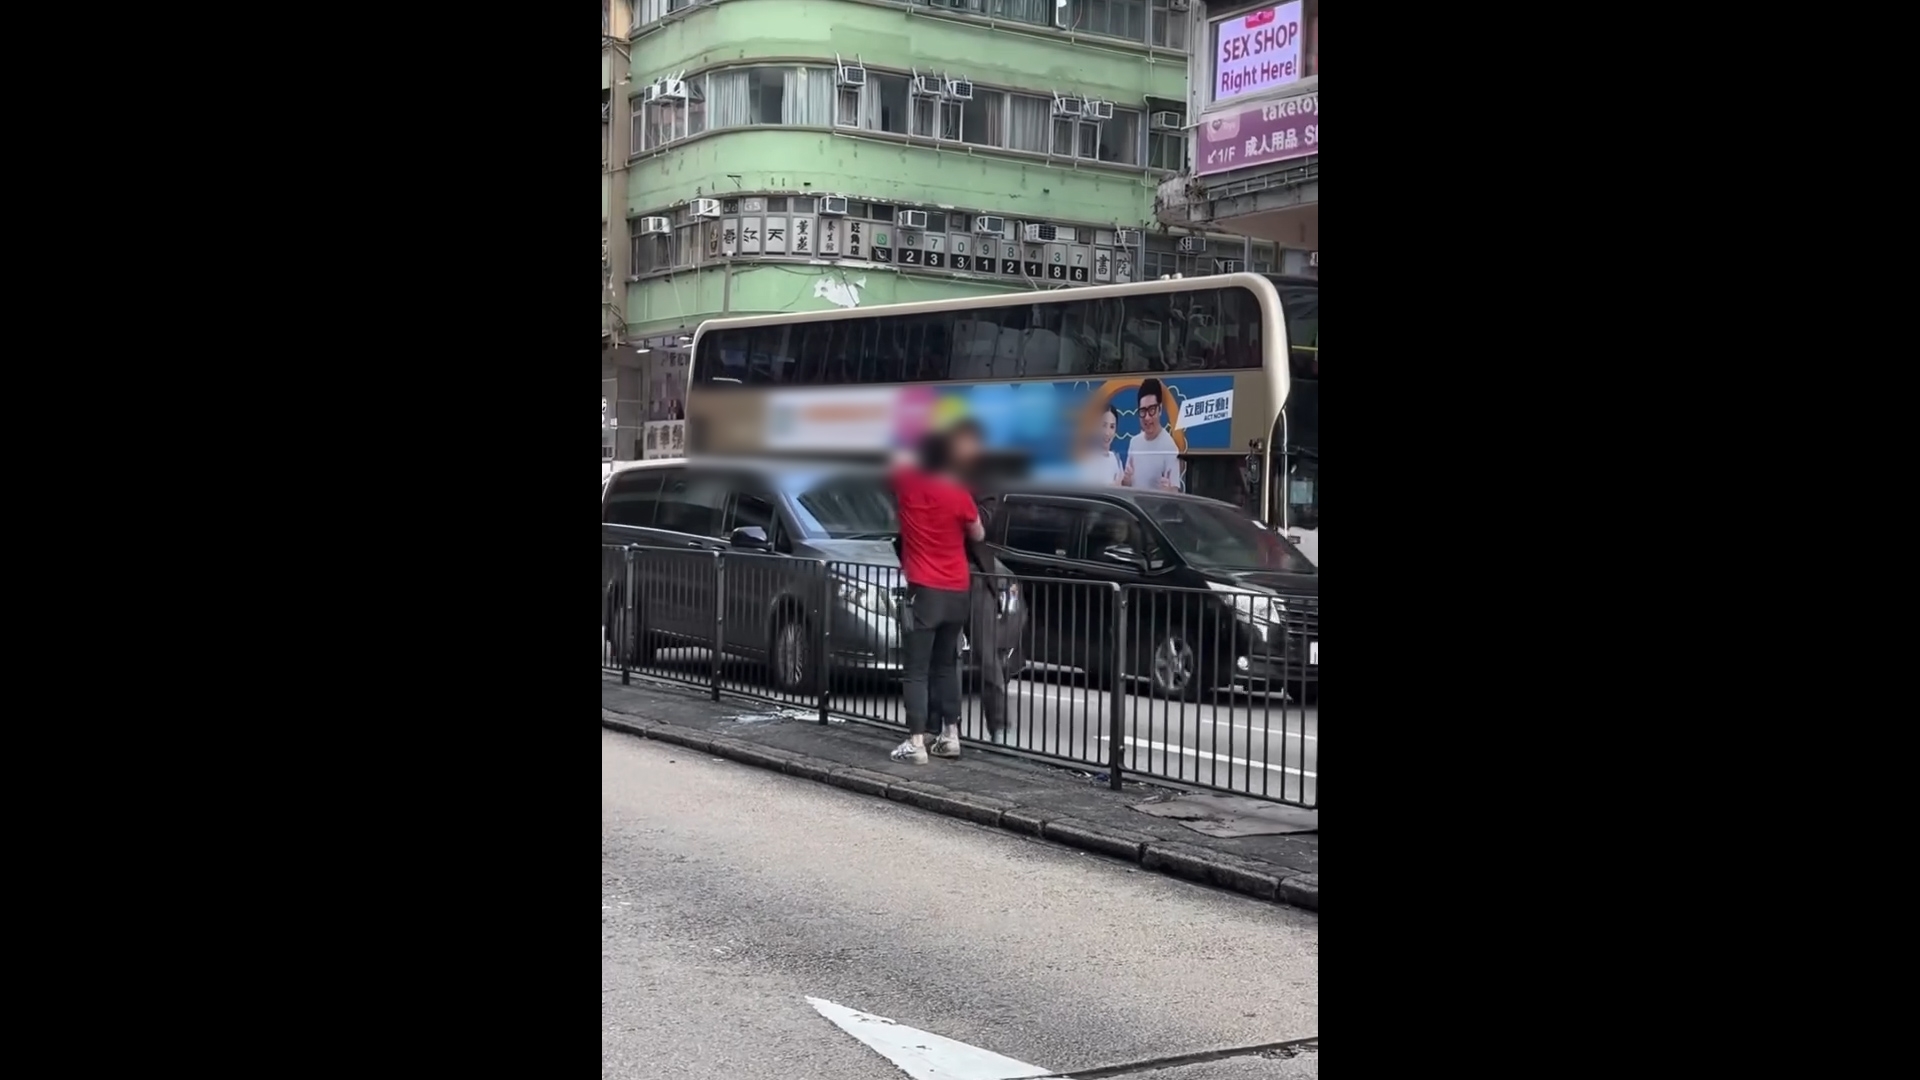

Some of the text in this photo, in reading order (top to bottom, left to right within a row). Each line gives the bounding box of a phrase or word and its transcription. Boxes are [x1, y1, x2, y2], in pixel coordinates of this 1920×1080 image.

[1223, 21, 1298, 63] SEX SHOP
[1221, 53, 1297, 94] Right Here!
[1217, 125, 1318, 163] 1/F 成人用品 S
[851, 222, 860, 256] 旺角店
